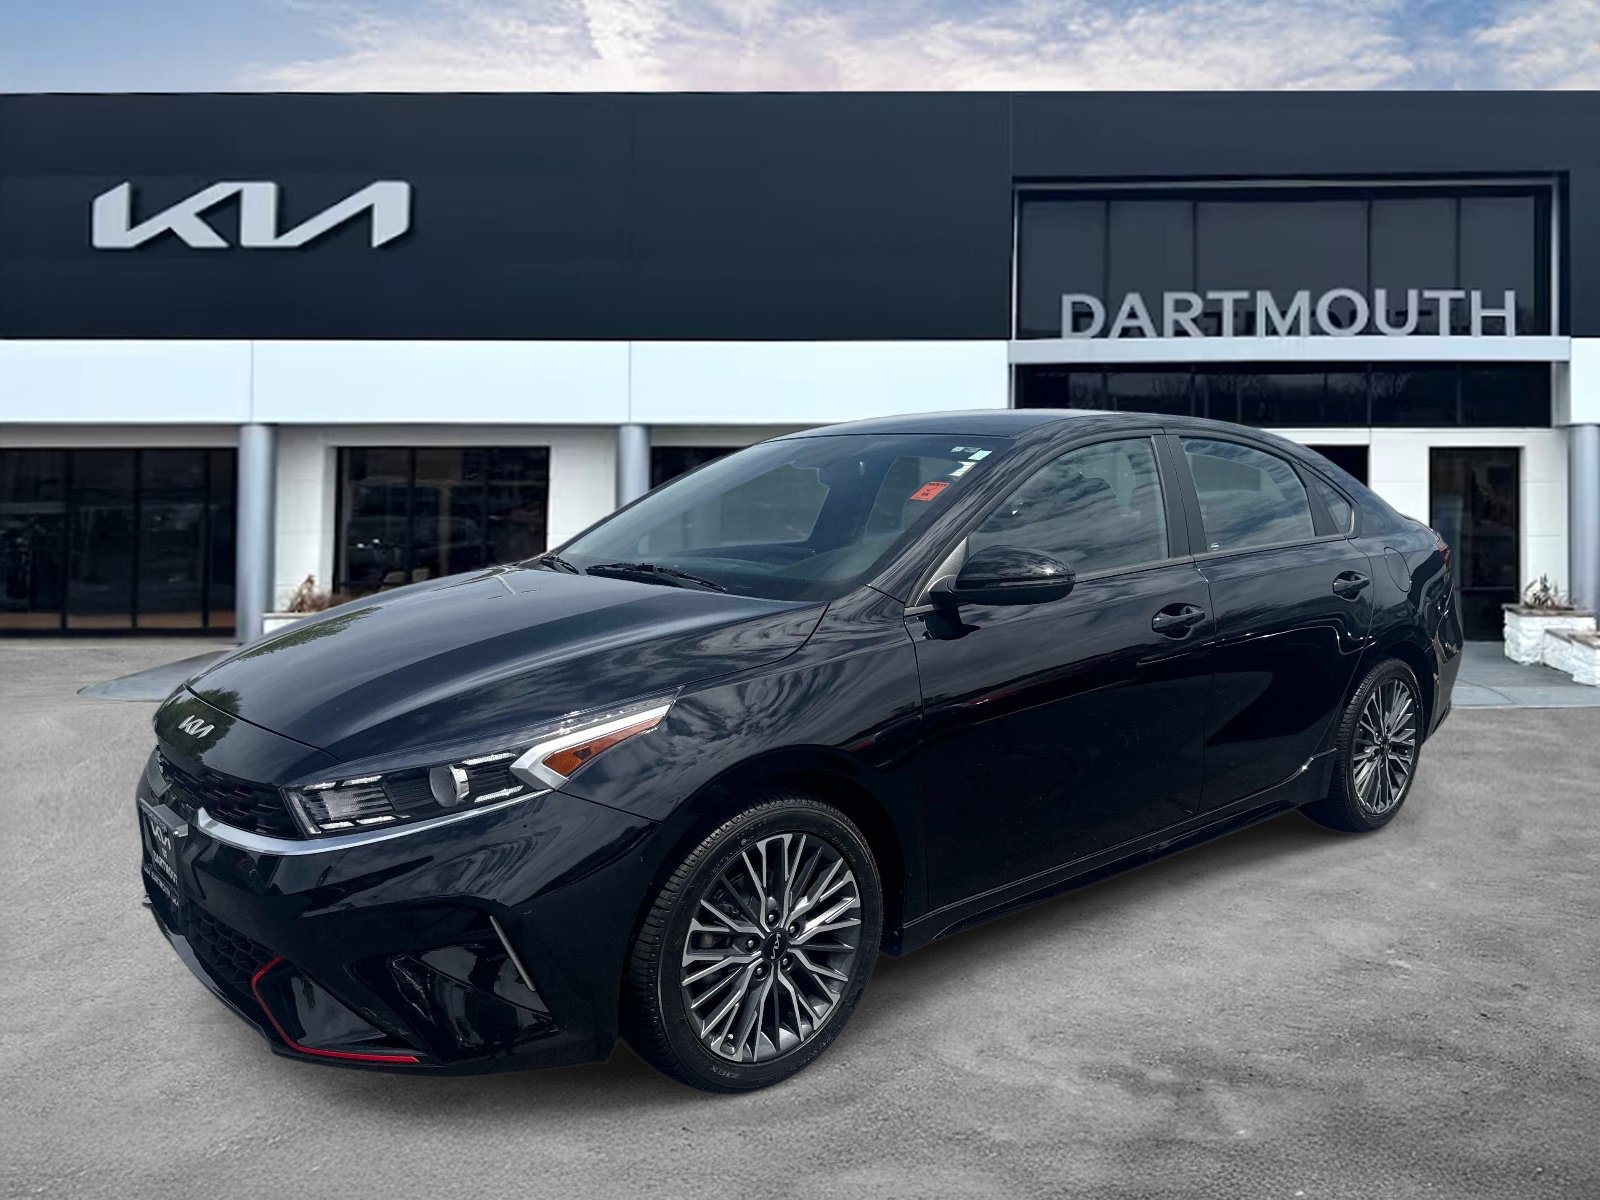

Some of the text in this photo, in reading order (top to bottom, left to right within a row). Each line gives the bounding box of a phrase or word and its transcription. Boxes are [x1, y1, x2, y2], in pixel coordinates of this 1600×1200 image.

[92, 180, 411, 249] KIA
[1061, 287, 1517, 338] DARTMOUTH
[178, 714, 215, 739] KIA
